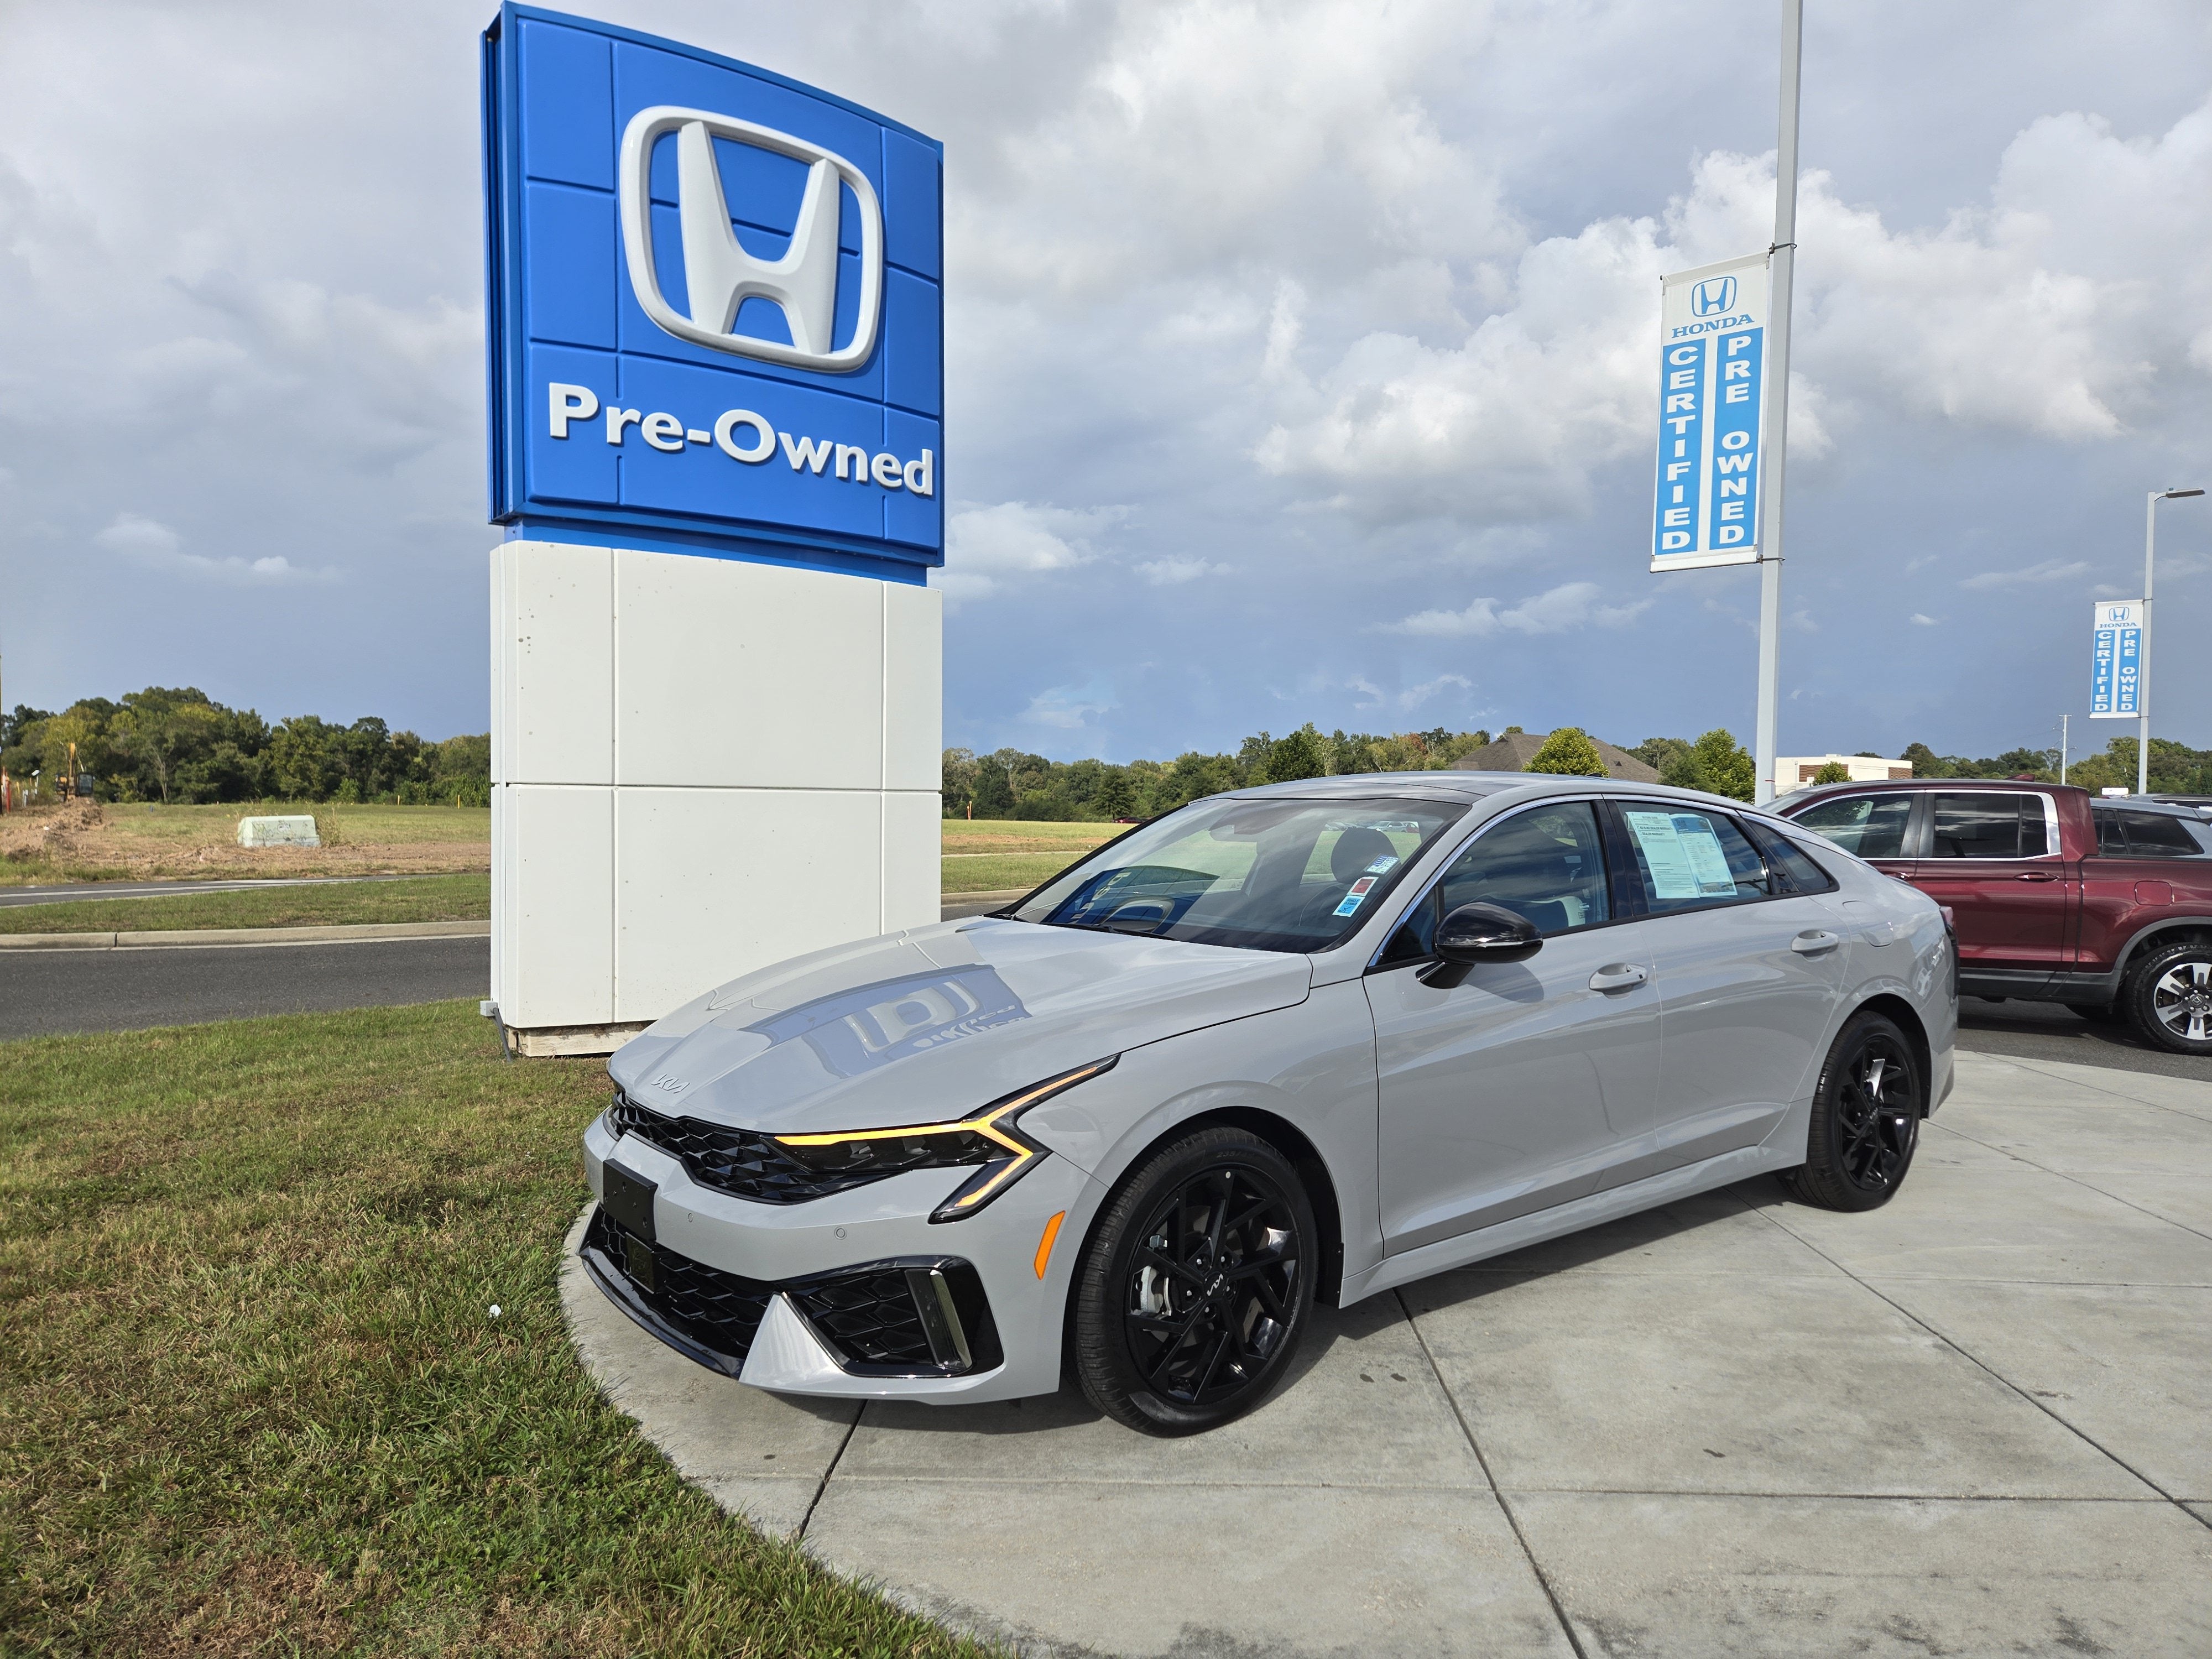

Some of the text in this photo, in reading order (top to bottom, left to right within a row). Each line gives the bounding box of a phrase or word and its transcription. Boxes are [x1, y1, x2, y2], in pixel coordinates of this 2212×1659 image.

[1671, 314, 1754, 338] HONDA
[549, 382, 933, 497] Pre-Owned
[1662, 346, 1699, 550] CERTIFIED
[1717, 335, 1753, 545] PRE OWNED
[2094, 631, 2112, 711] CERTIFIED
[2120, 630, 2137, 711] PRE OWNED
[650, 1073, 690, 1094] KIA
